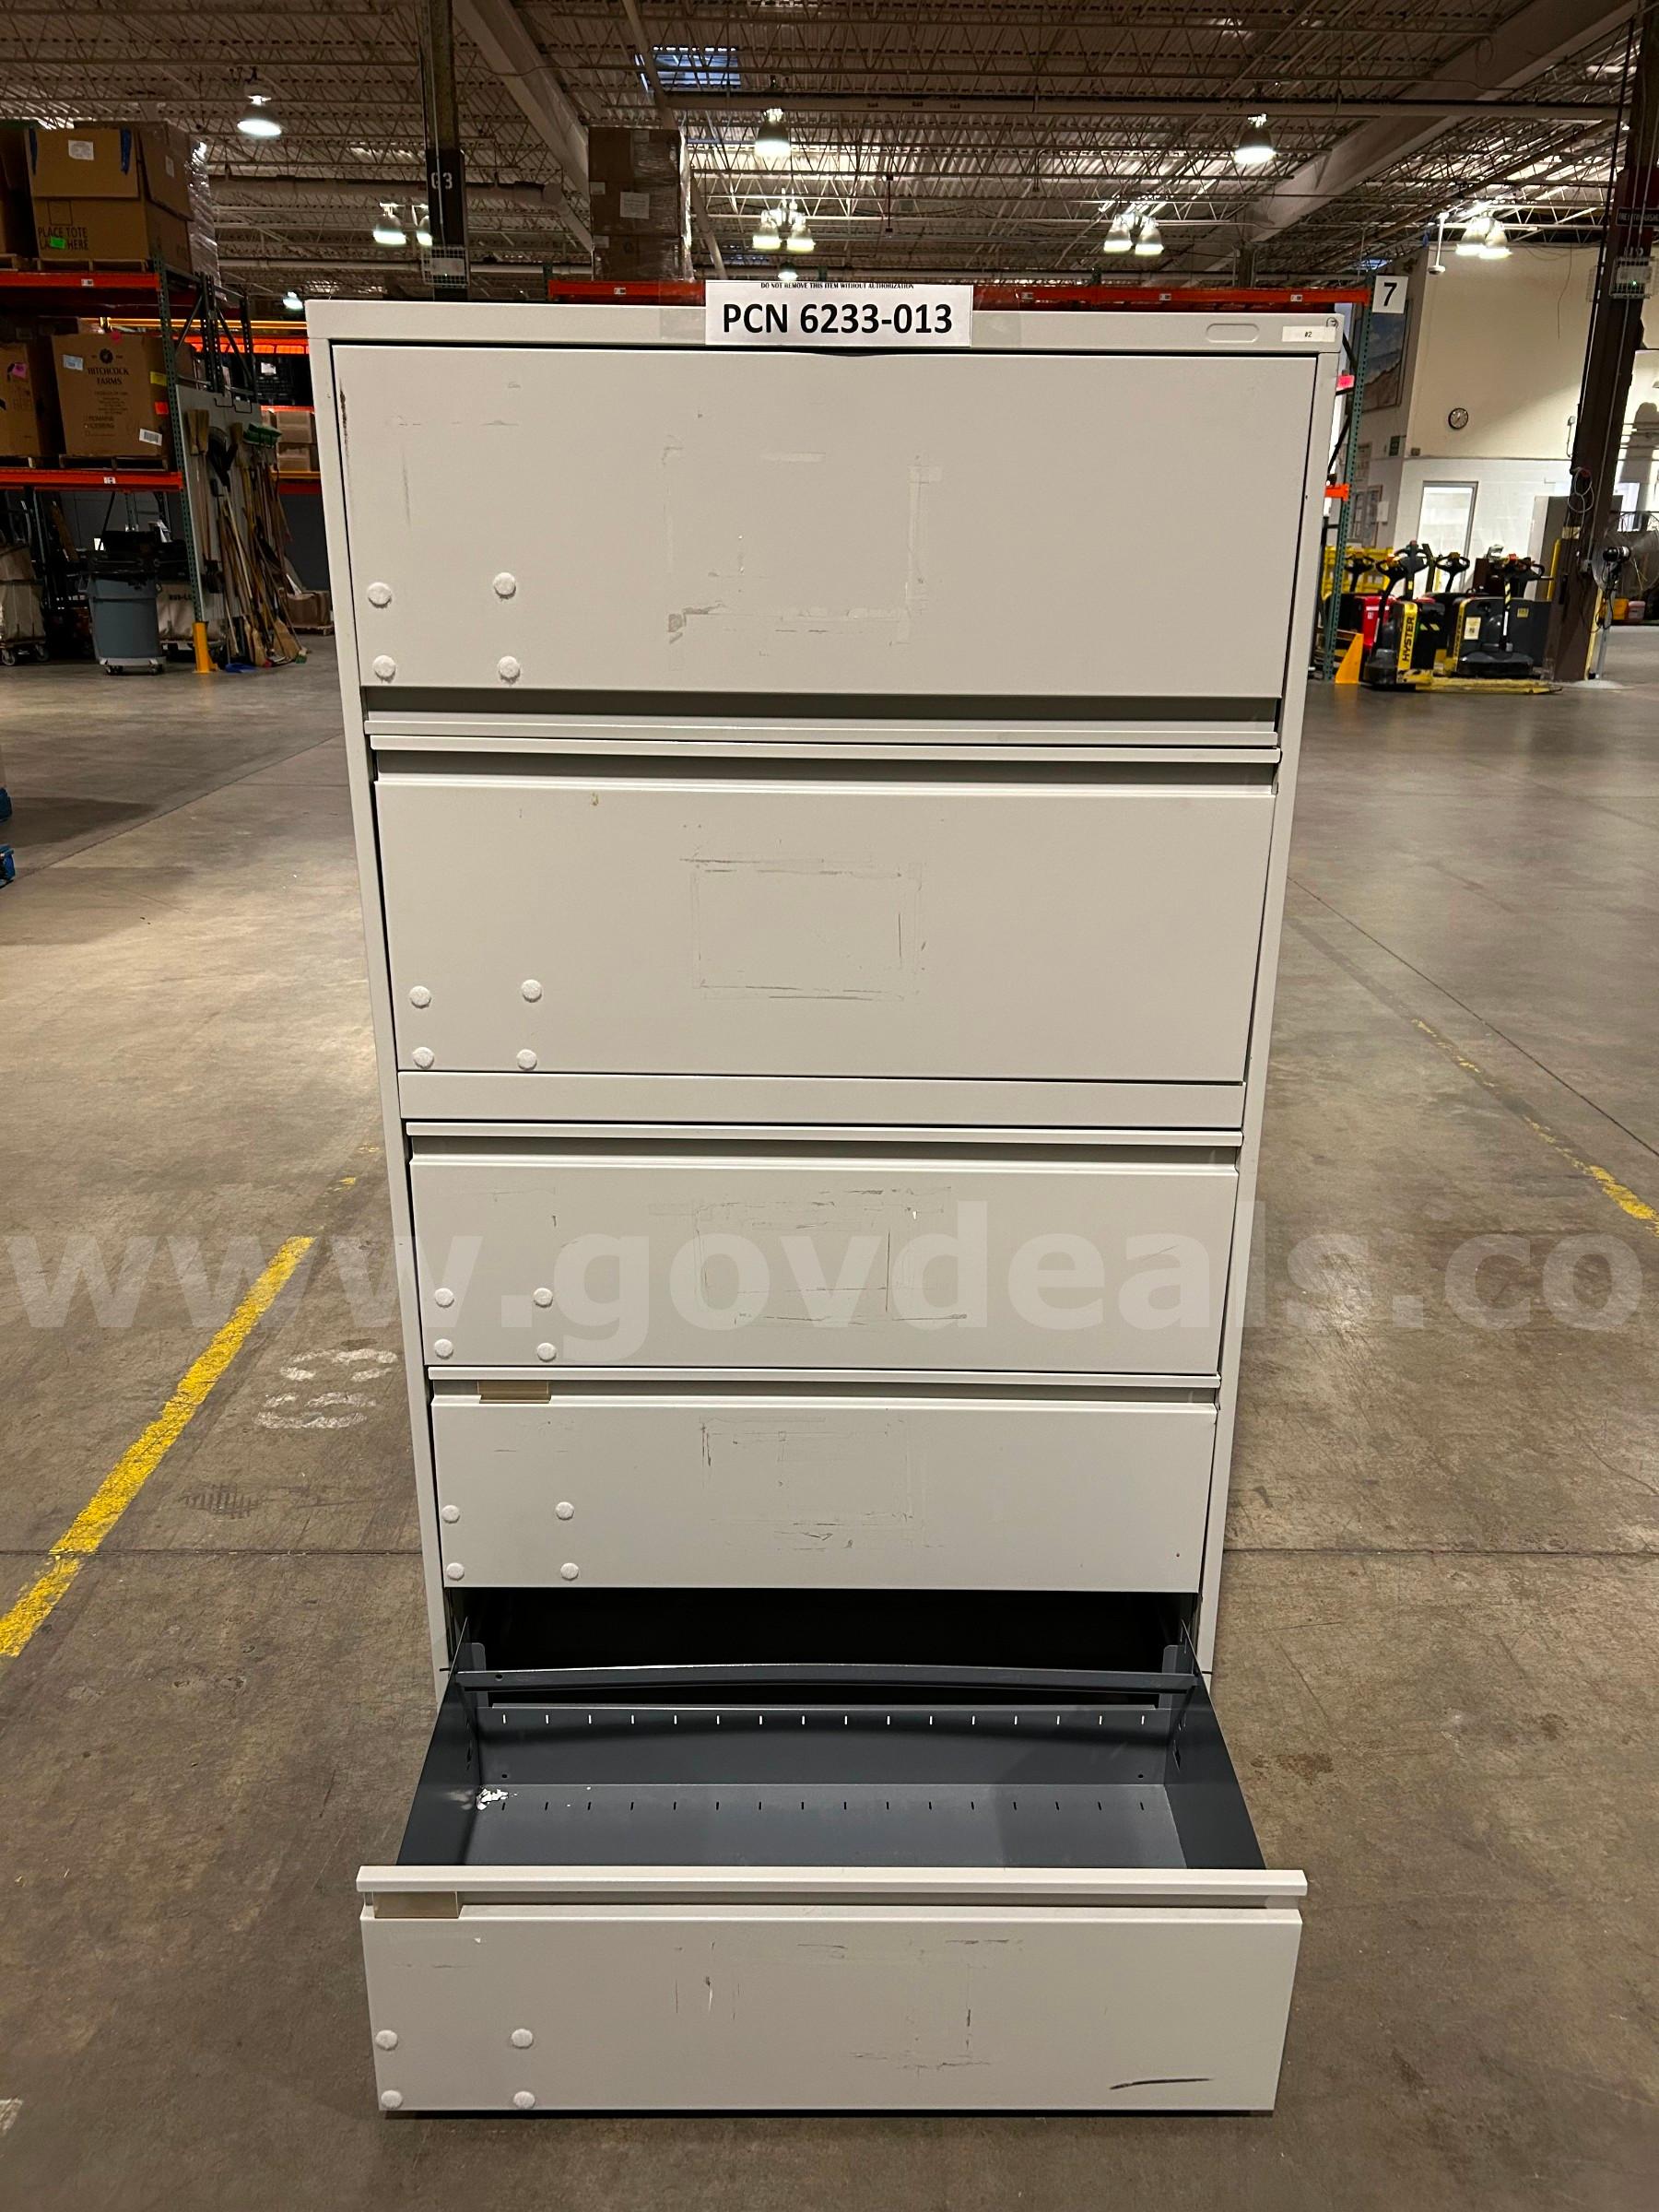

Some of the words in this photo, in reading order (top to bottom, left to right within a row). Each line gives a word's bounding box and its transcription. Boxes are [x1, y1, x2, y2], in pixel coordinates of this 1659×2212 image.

[38, 227, 63, 238] PLACE
[66, 227, 88, 238] TOTE
[67, 239, 89, 251] HERE
[1383, 282, 1397, 307] 7
[724, 303, 788, 333] PCN
[800, 303, 952, 334] 6233-013
[1402, 617, 1415, 663] HYSTER
